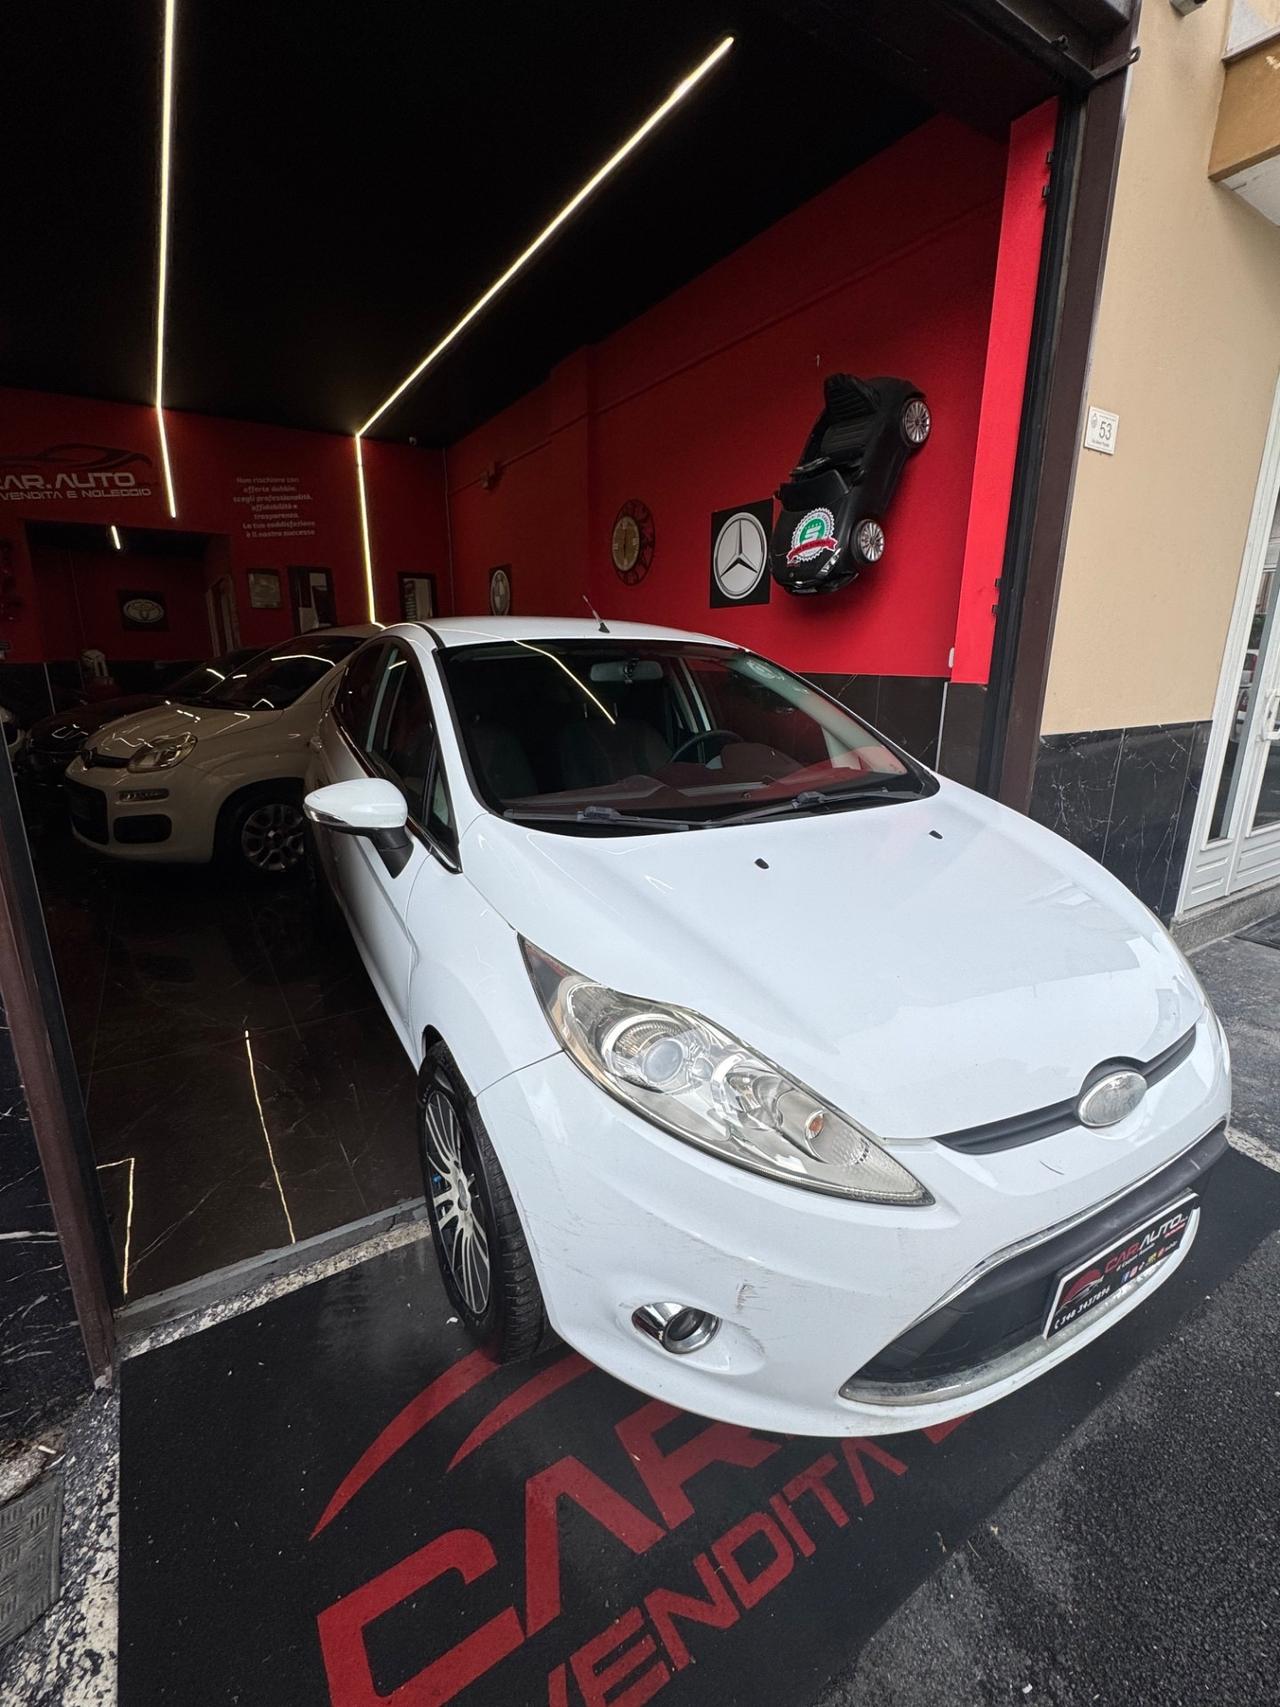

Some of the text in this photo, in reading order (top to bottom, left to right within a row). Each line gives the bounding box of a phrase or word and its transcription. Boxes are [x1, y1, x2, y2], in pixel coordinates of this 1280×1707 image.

[1098, 420, 1112, 441] 53
[0, 471, 137, 490] AR.AUTO
[66, 489, 78, 499] E
[81, 488, 152, 499] NOLEGGIO
